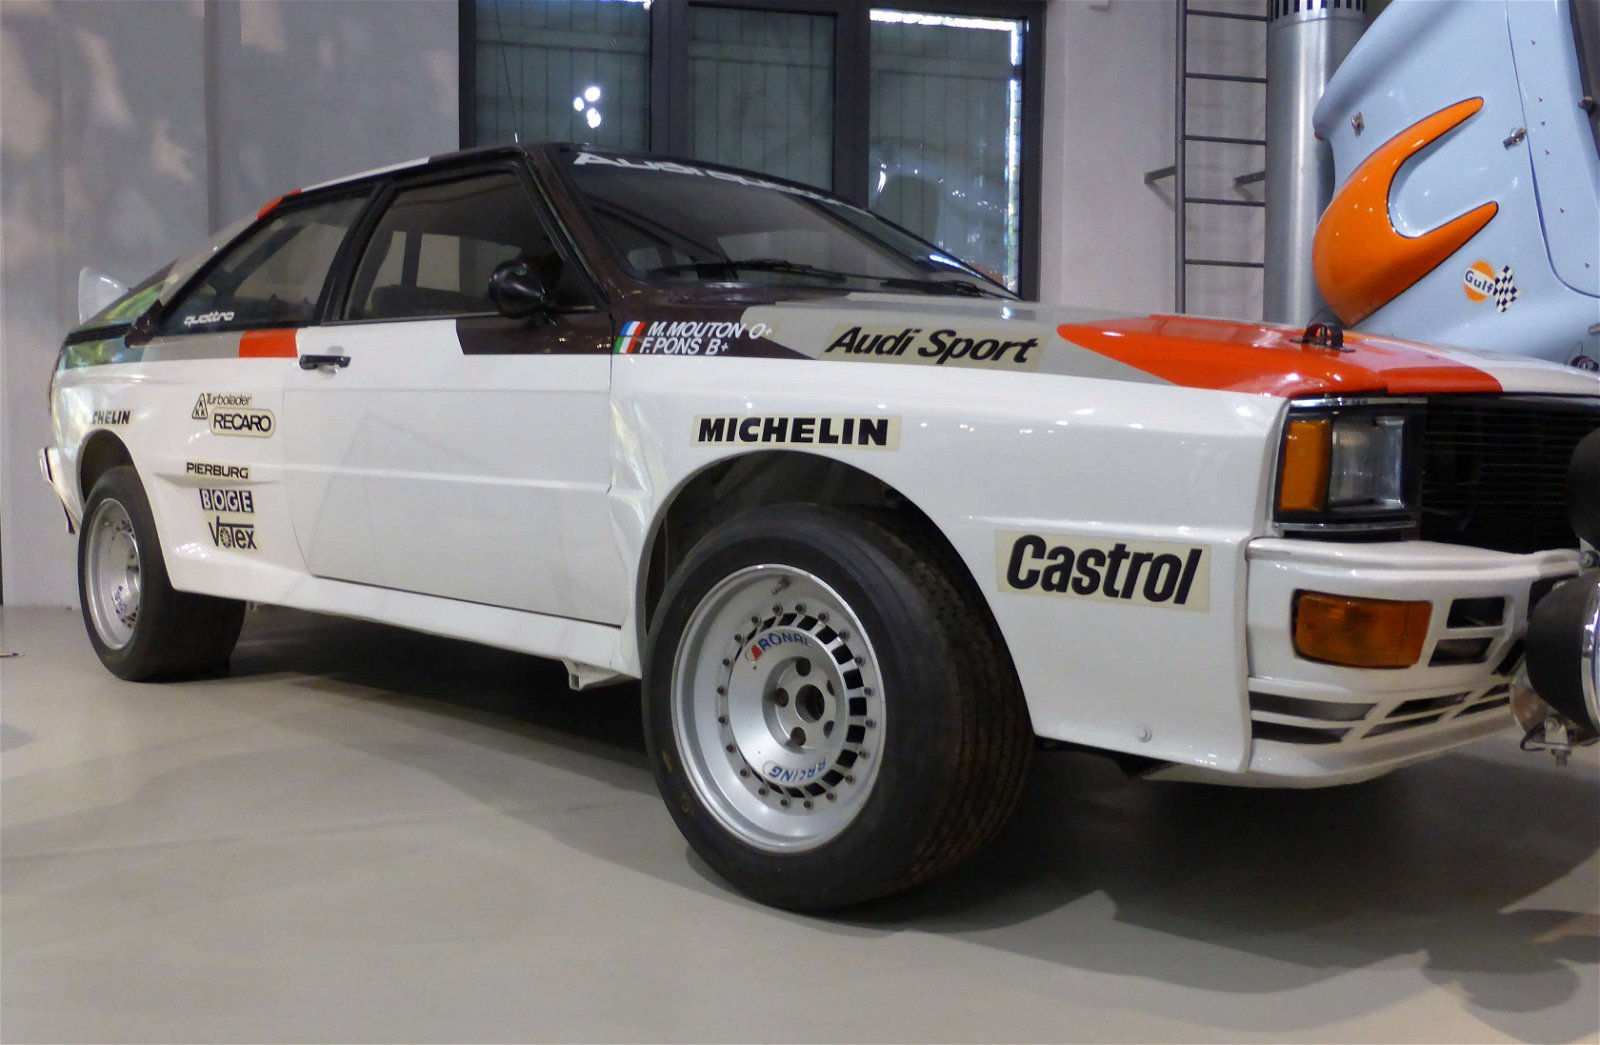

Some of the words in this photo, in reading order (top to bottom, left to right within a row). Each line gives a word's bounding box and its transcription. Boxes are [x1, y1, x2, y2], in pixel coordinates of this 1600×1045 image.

[1464, 269, 1495, 294] Gulf
[183, 310, 235, 328] quattro
[704, 338, 729, 355] B+
[824, 326, 919, 356] Audi
[917, 328, 1040, 366] Sport
[207, 393, 252, 406] Turbolader
[92, 409, 131, 425] CHELIN
[213, 412, 271, 433] RECARO
[698, 416, 889, 446] MICHELIN
[186, 462, 249, 479] PIERBURG
[201, 489, 253, 513] BOGE
[1006, 534, 1203, 605] Castrol
[759, 632, 813, 651] RONAL
[768, 757, 828, 784] RACING
